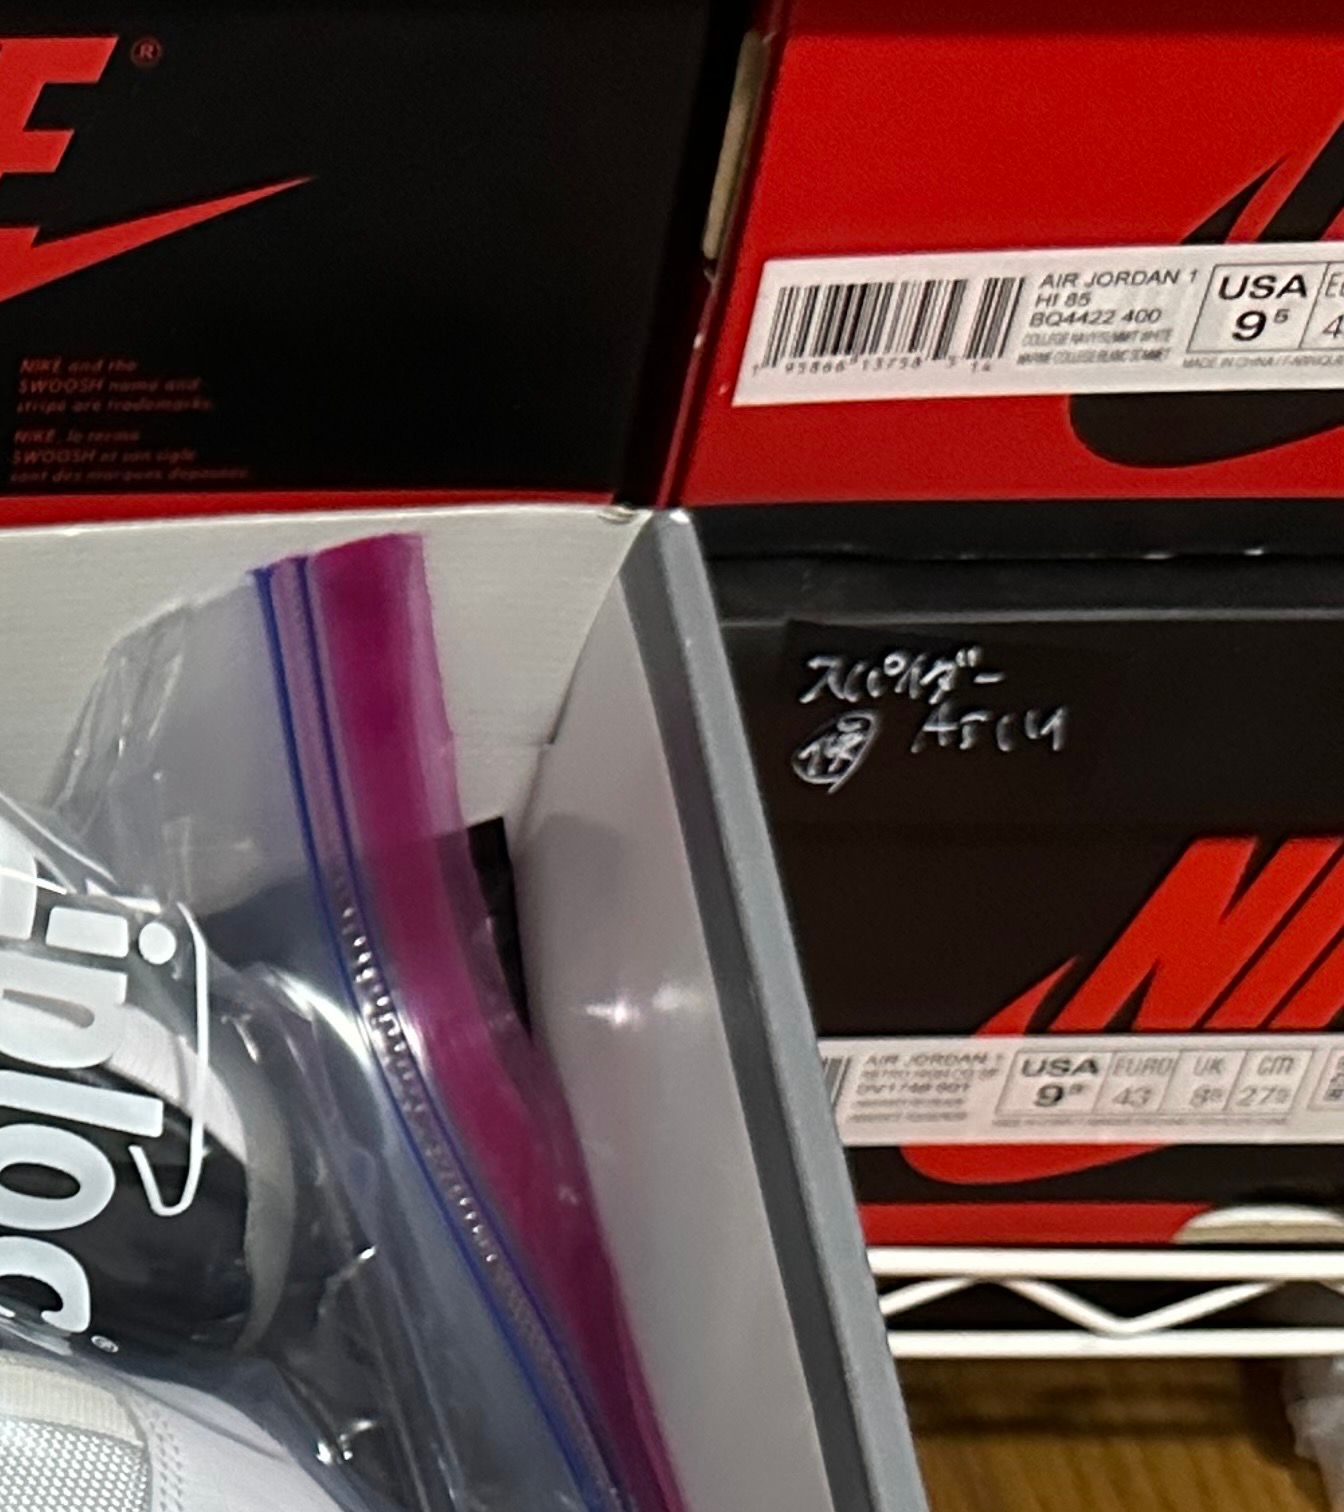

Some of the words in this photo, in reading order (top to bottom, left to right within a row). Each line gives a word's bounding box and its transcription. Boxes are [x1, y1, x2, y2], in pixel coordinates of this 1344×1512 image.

[1039, 272, 1080, 288] AIR
[1085, 268, 1181, 287] JORDAN
[1189, 269, 1198, 283] 1
[1218, 274, 1307, 300] USA
[1034, 293, 1059, 308] HI
[1065, 292, 1091, 307] 85
[1028, 311, 1116, 328] BQ4422
[1120, 308, 1163, 324] 400
[18, 378, 103, 393] SWOOSH
[11, 450, 95, 465] SWOOSH
[904, 1052, 988, 1067] JORDAN
[1020, 1057, 1101, 1077] USA
[1113, 1056, 1171, 1078] EURO
[1194, 1056, 1224, 1077] UK
[1114, 1086, 1151, 1108] 43
